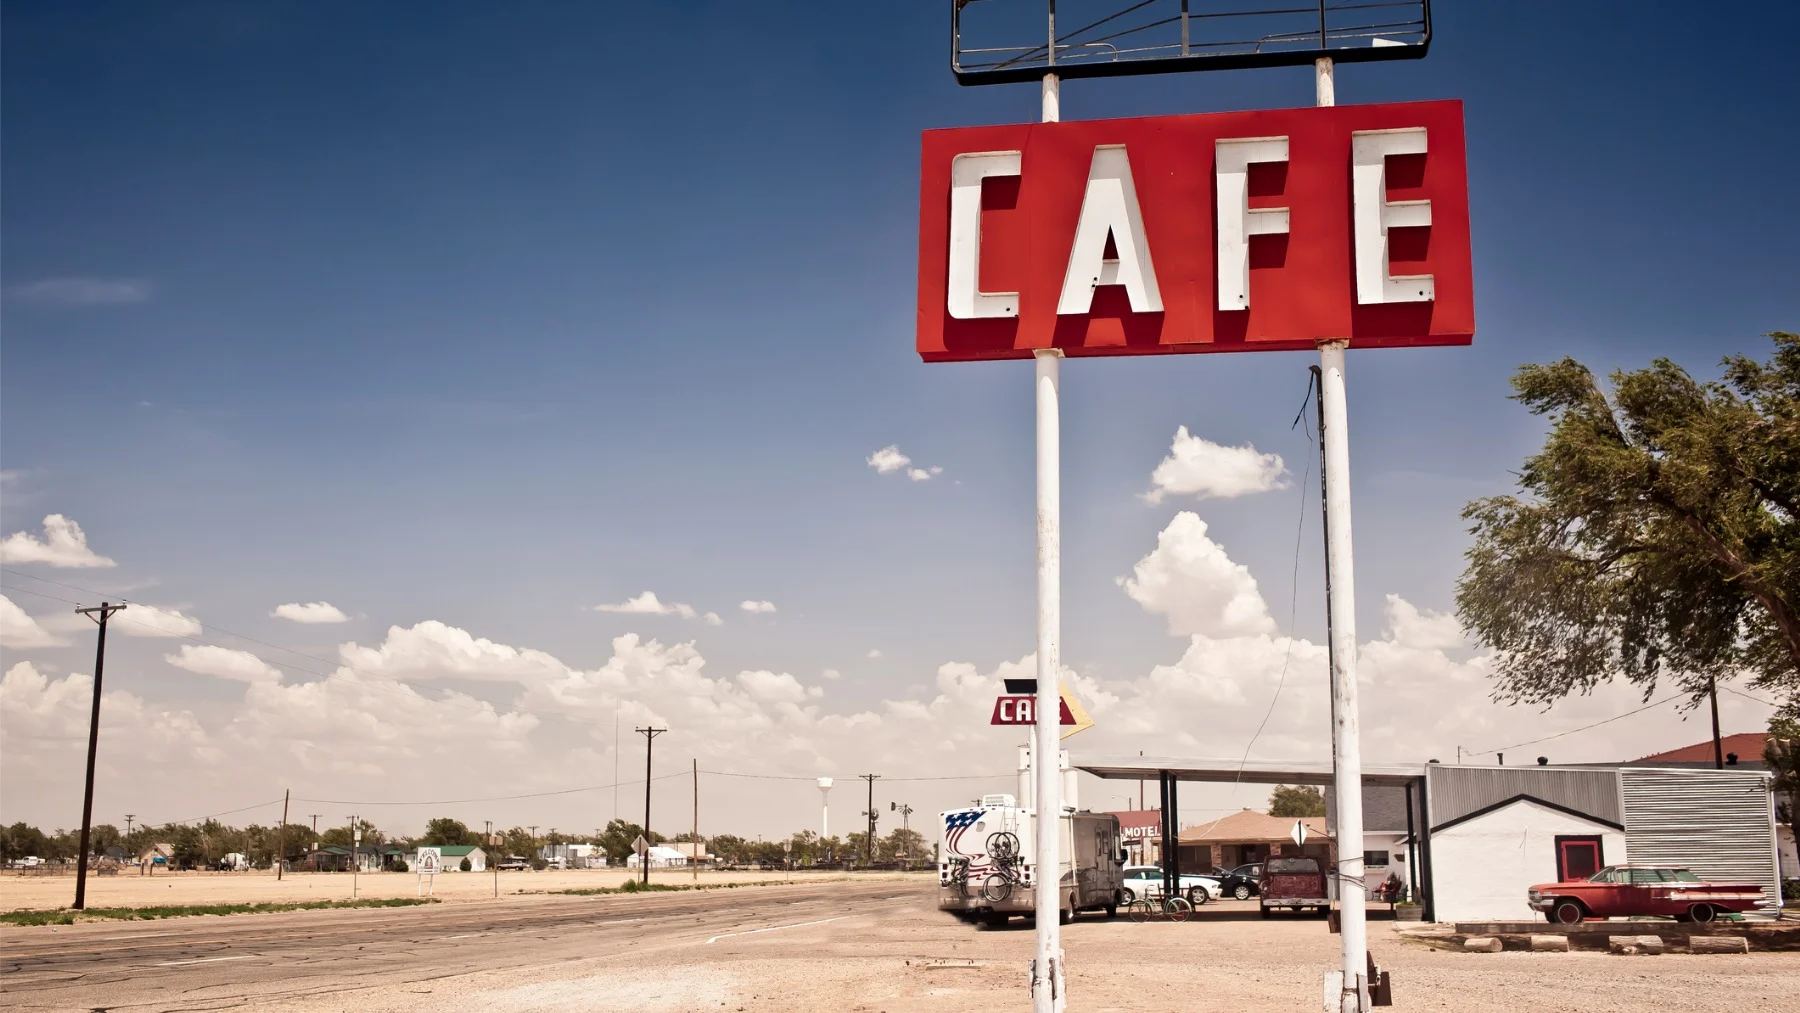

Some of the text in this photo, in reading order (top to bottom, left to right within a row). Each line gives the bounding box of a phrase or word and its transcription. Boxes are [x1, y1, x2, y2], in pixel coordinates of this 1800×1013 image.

[948, 126, 1434, 319] CAFE
[1000, 699, 1061, 722] CA
[1124, 826, 1161, 837] MOTEL
